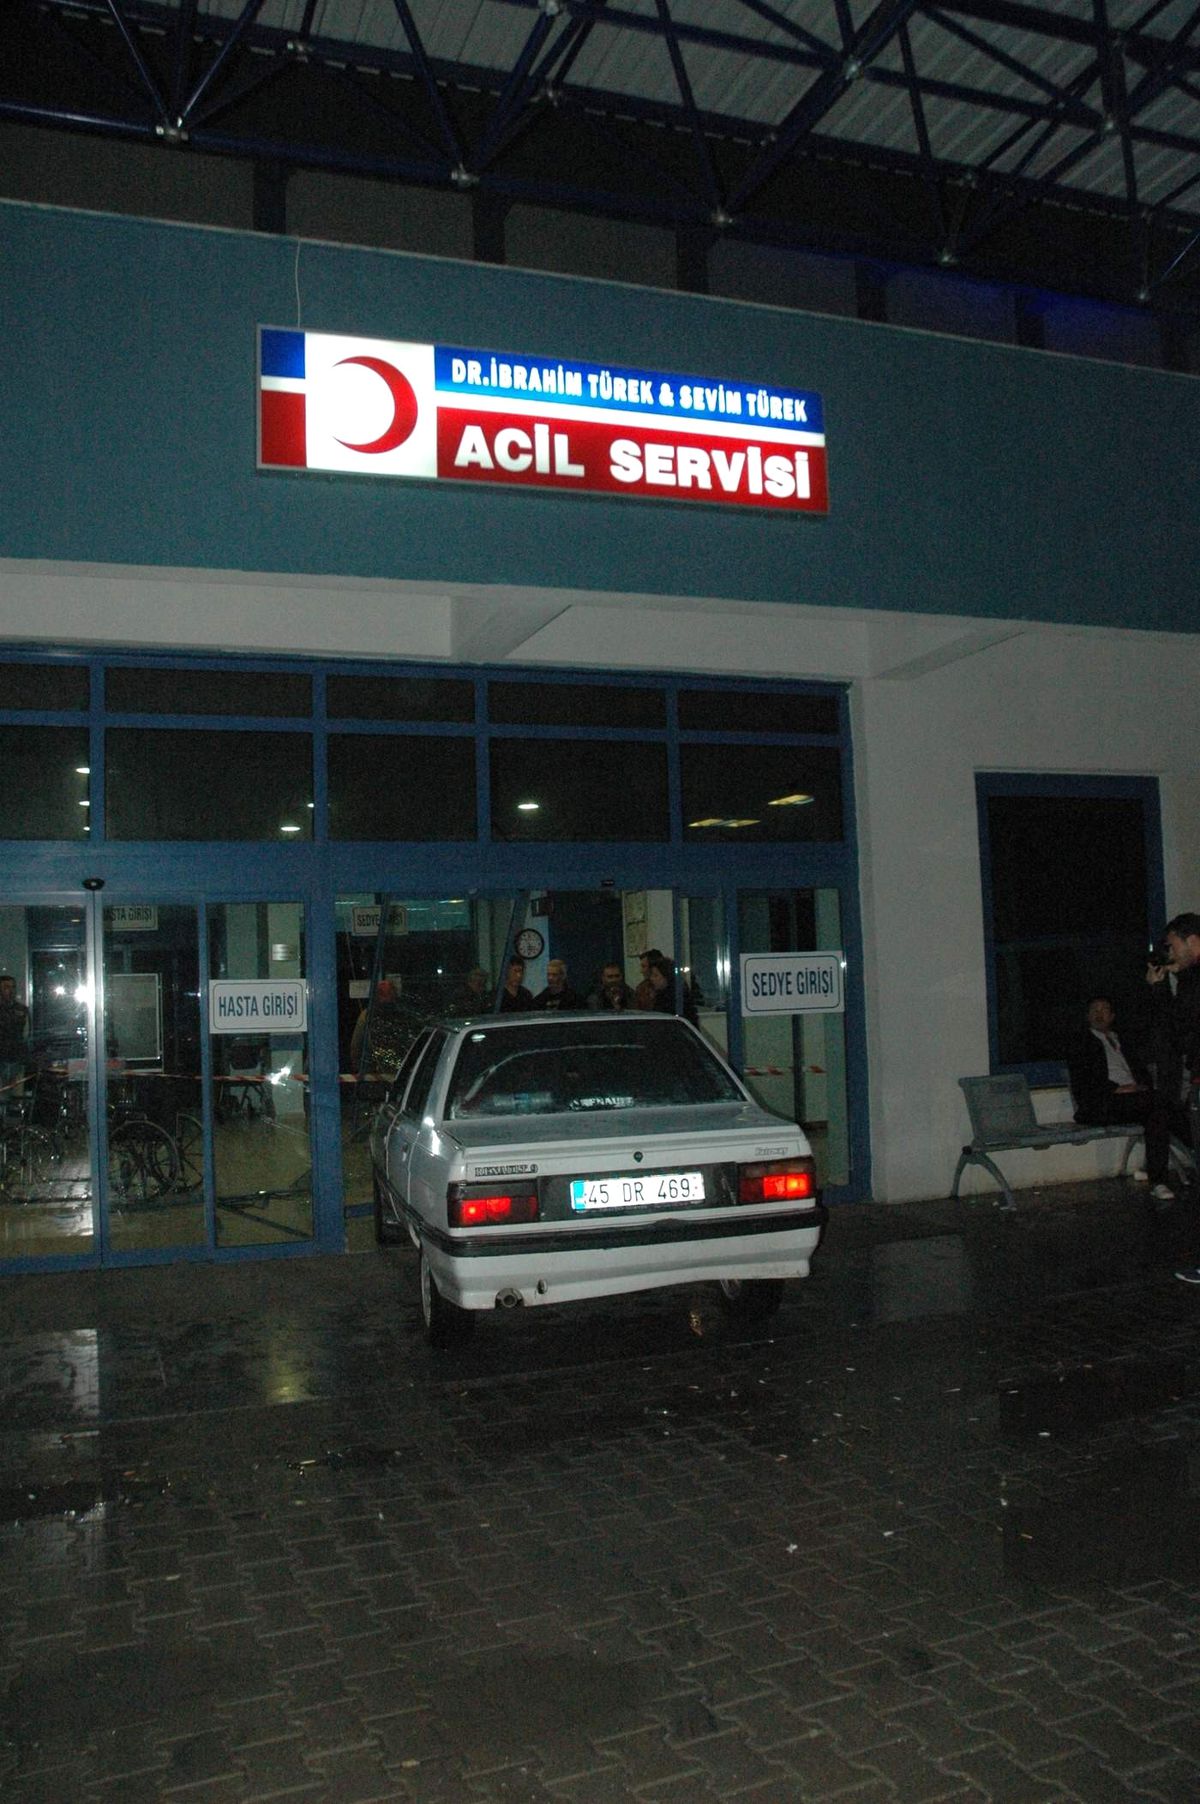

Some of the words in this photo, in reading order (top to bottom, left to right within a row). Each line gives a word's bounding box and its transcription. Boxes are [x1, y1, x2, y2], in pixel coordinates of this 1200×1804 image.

[452, 357, 582, 397] DR.İBRAHİM
[588, 370, 654, 405] TÜREK
[659, 383, 674, 407] &
[679, 384, 742, 415] SEVİM
[746, 389, 807, 422] TÜREK
[454, 423, 585, 477] ACİL
[610, 439, 811, 499] SERVİSİ
[752, 972, 792, 997] SEDYE
[796, 966, 833, 997] GİRİŞİ
[219, 995, 259, 1016] HASTA
[263, 992, 298, 1018] GİRİŞİ
[589, 1184, 609, 1203] 45
[622, 1181, 644, 1203] DR
[658, 1178, 690, 1199] 469
